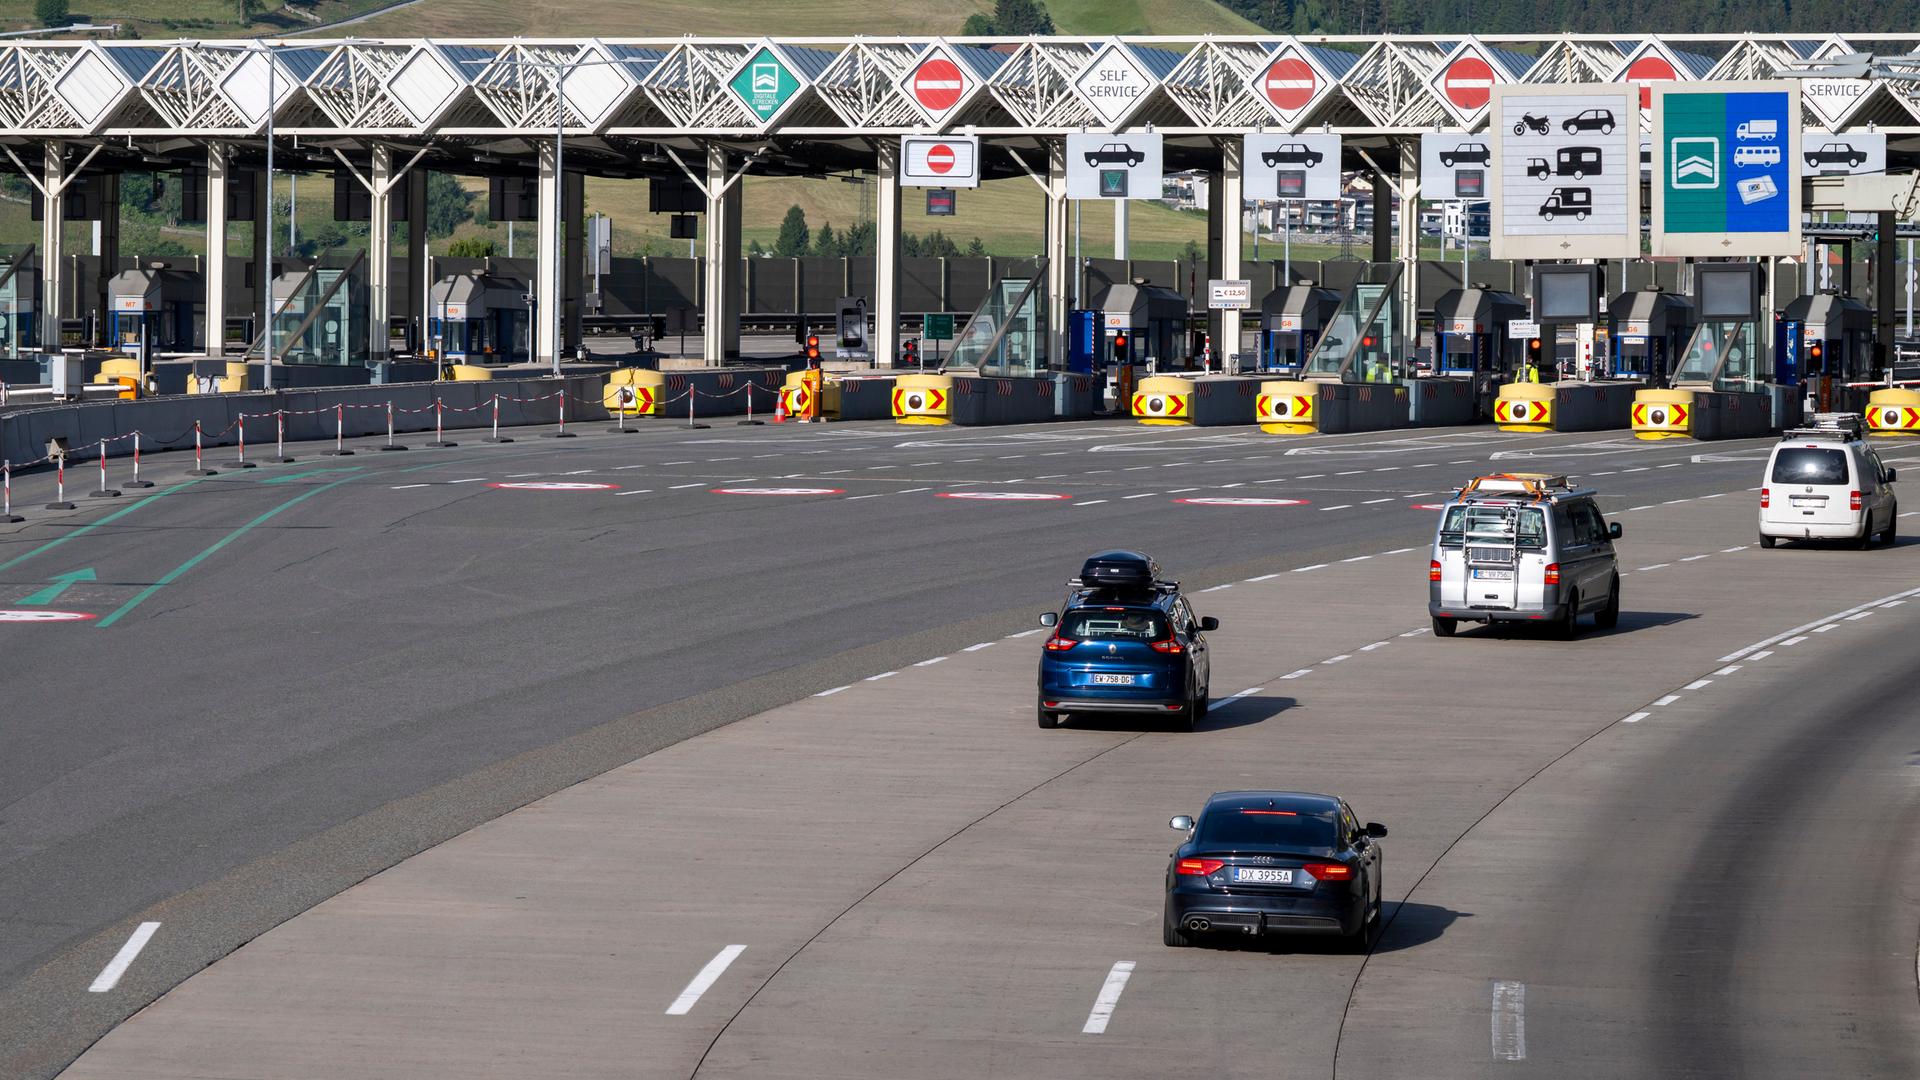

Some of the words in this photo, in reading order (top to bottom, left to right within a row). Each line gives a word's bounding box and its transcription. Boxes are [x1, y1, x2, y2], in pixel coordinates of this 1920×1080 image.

[1100, 70, 1128, 81] SELF
[1089, 85, 1138, 97] SERVICE
[1809, 84, 1861, 96] SERVICE
[1240, 869, 1254, 880] DX
[1257, 870, 1289, 881] 3955A
